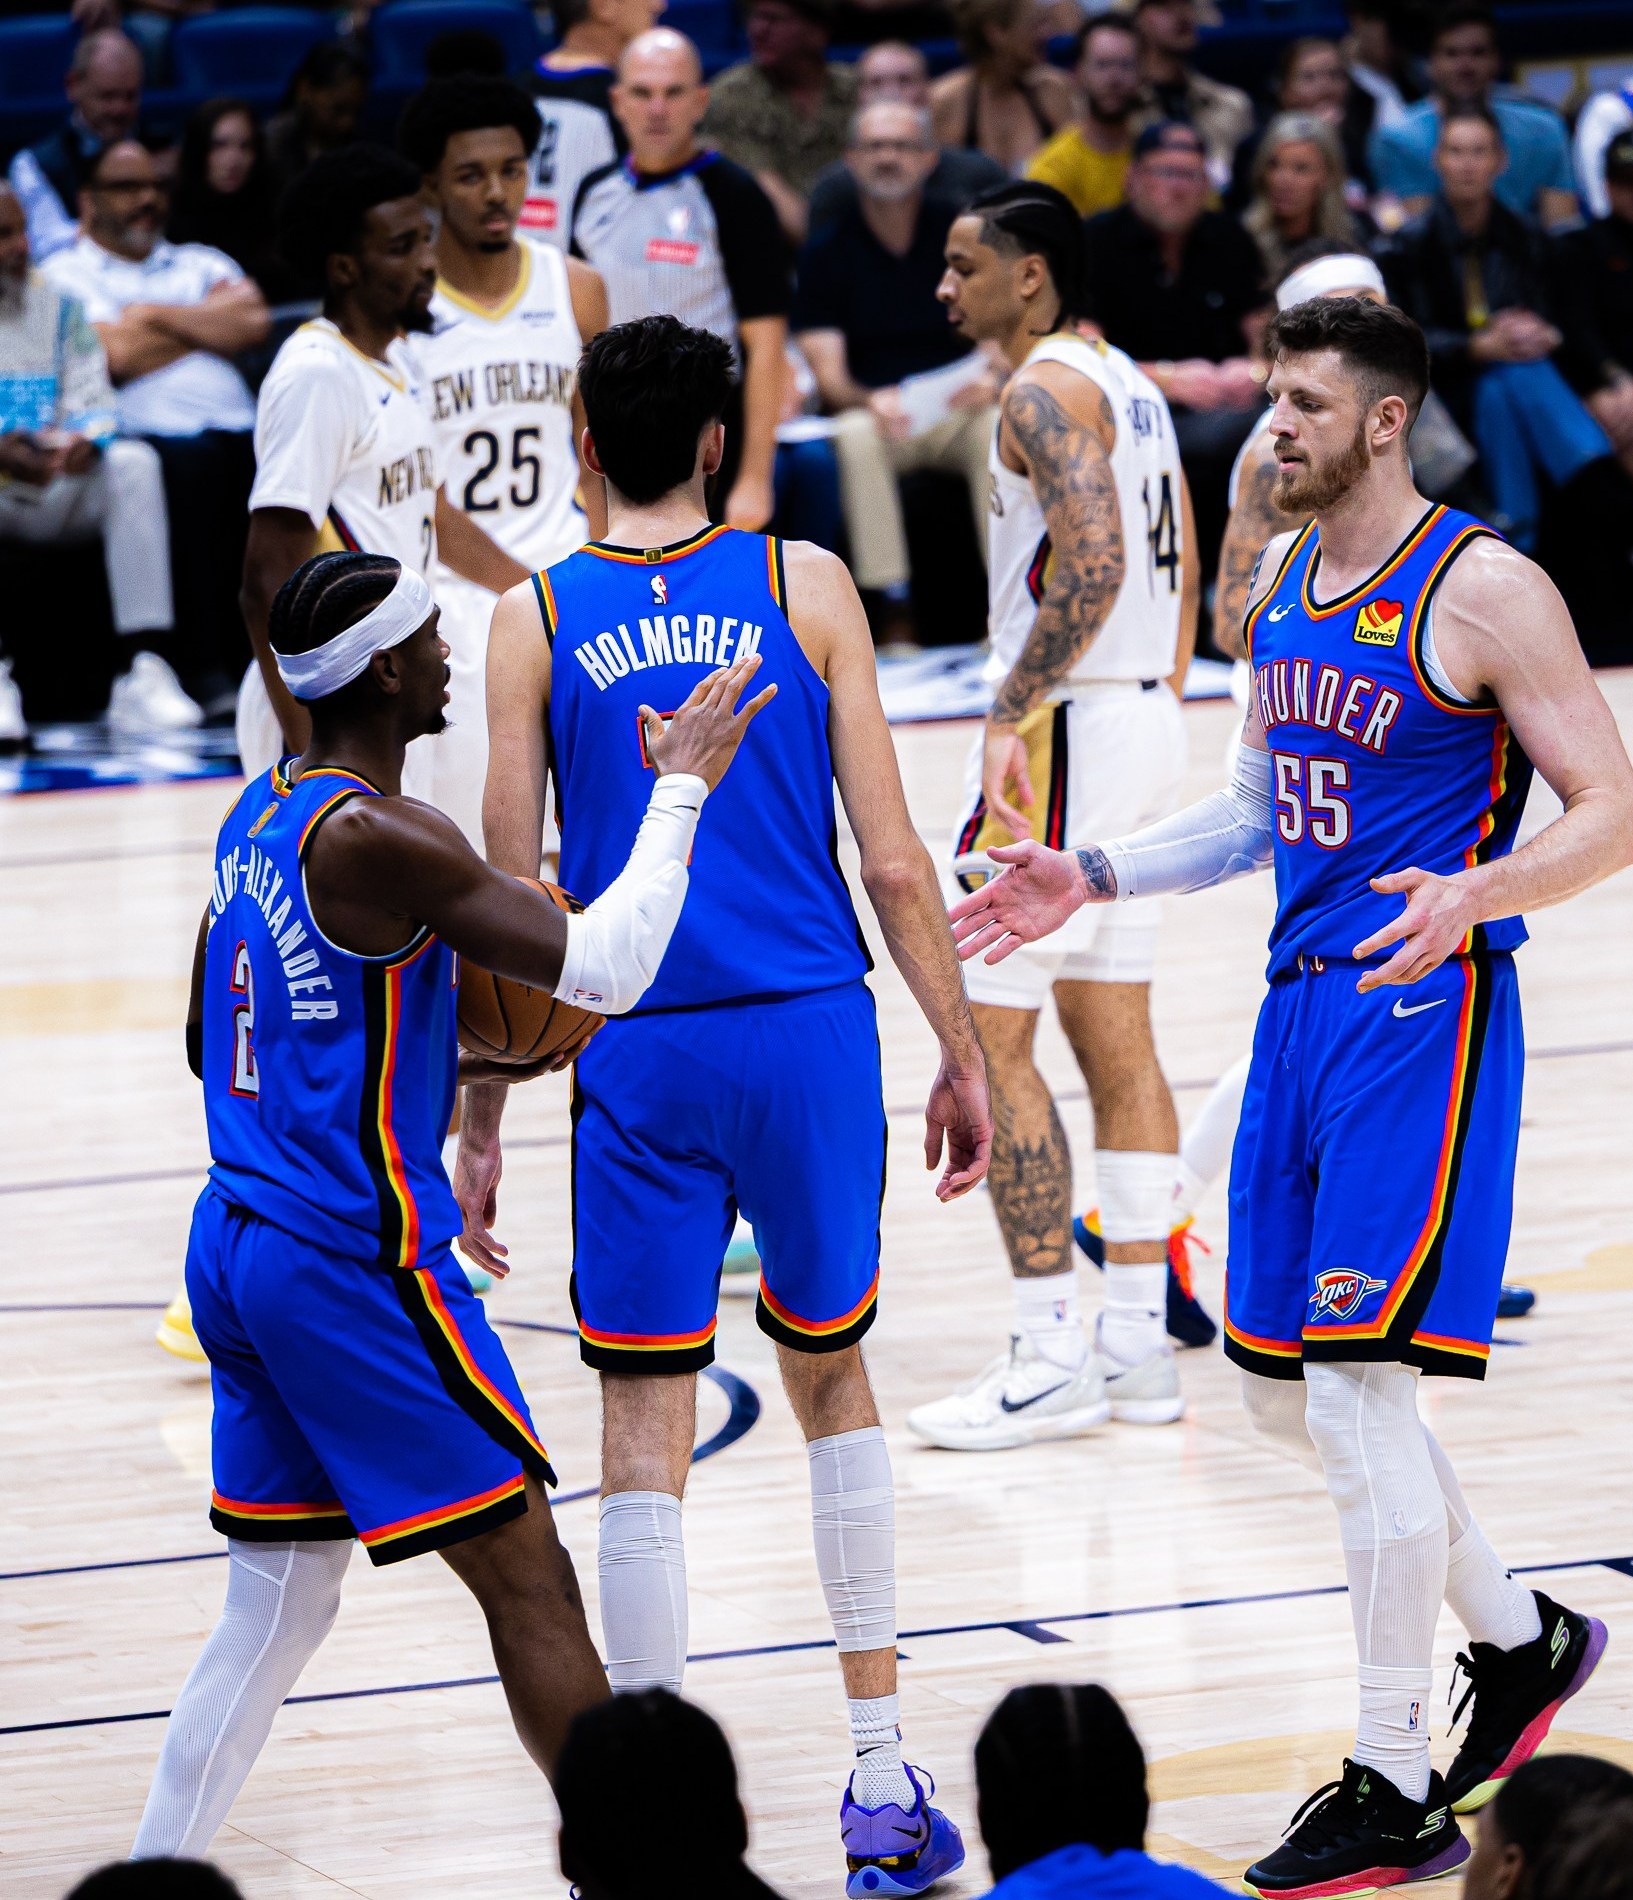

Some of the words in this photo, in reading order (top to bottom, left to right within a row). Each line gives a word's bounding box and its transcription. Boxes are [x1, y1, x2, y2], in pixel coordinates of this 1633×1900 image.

[463, 427, 542, 512] 25
[1142, 471, 1179, 599] 14
[573, 614, 764, 692] HOLMGREN
[1256, 657, 1404, 756] HUNDER
[1271, 749, 1353, 851] 55
[229, 939, 260, 1101] 2
[1318, 1279, 1356, 1308] OKC
